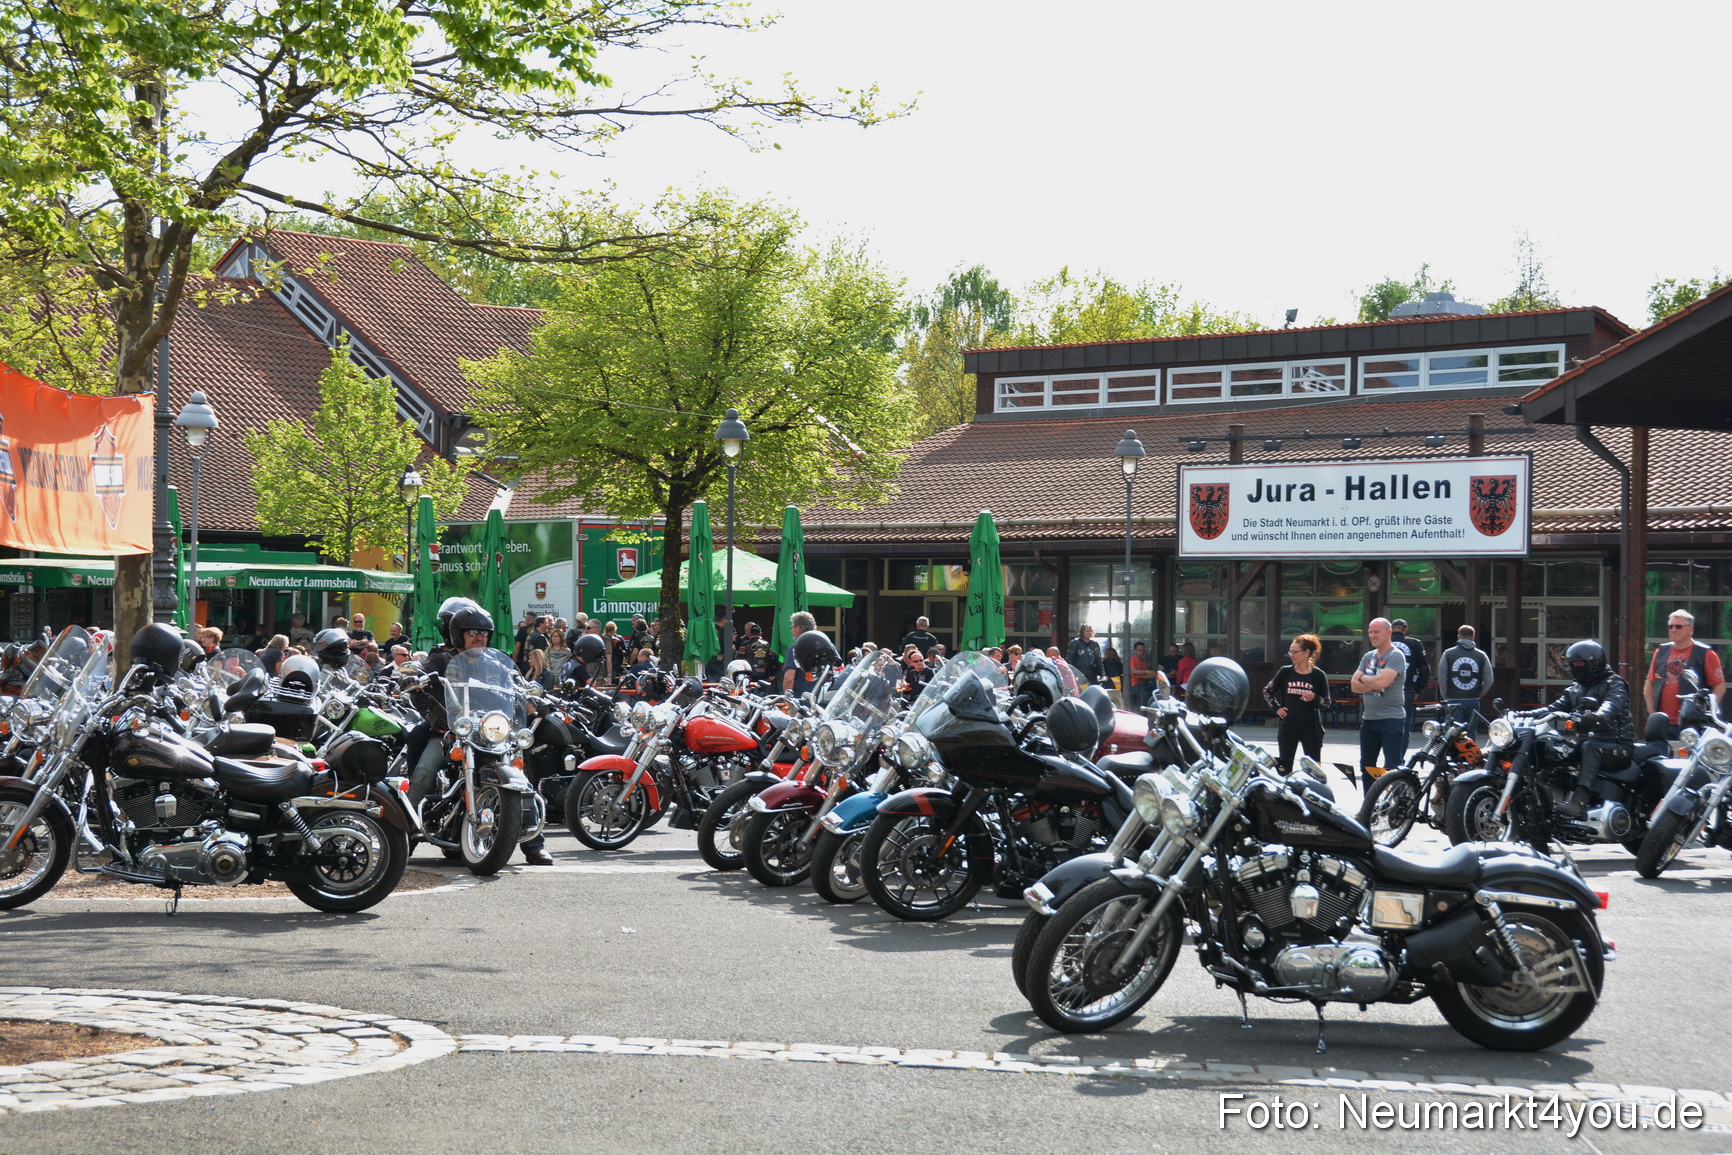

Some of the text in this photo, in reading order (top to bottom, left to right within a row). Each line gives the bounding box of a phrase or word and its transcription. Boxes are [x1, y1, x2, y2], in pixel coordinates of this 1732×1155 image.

[1247, 478, 1315, 503] Jura
[1345, 474, 1451, 500] Hallen
[1243, 514, 1452, 528] Die Stadt Neumarkt i. d. OPf. grüßt ihre Gäste
[1231, 528, 1465, 541] und wünscht Ihnen einen angenehmen Aufenthalt!
[249, 576, 357, 589] Neumarkter Lammsbräu
